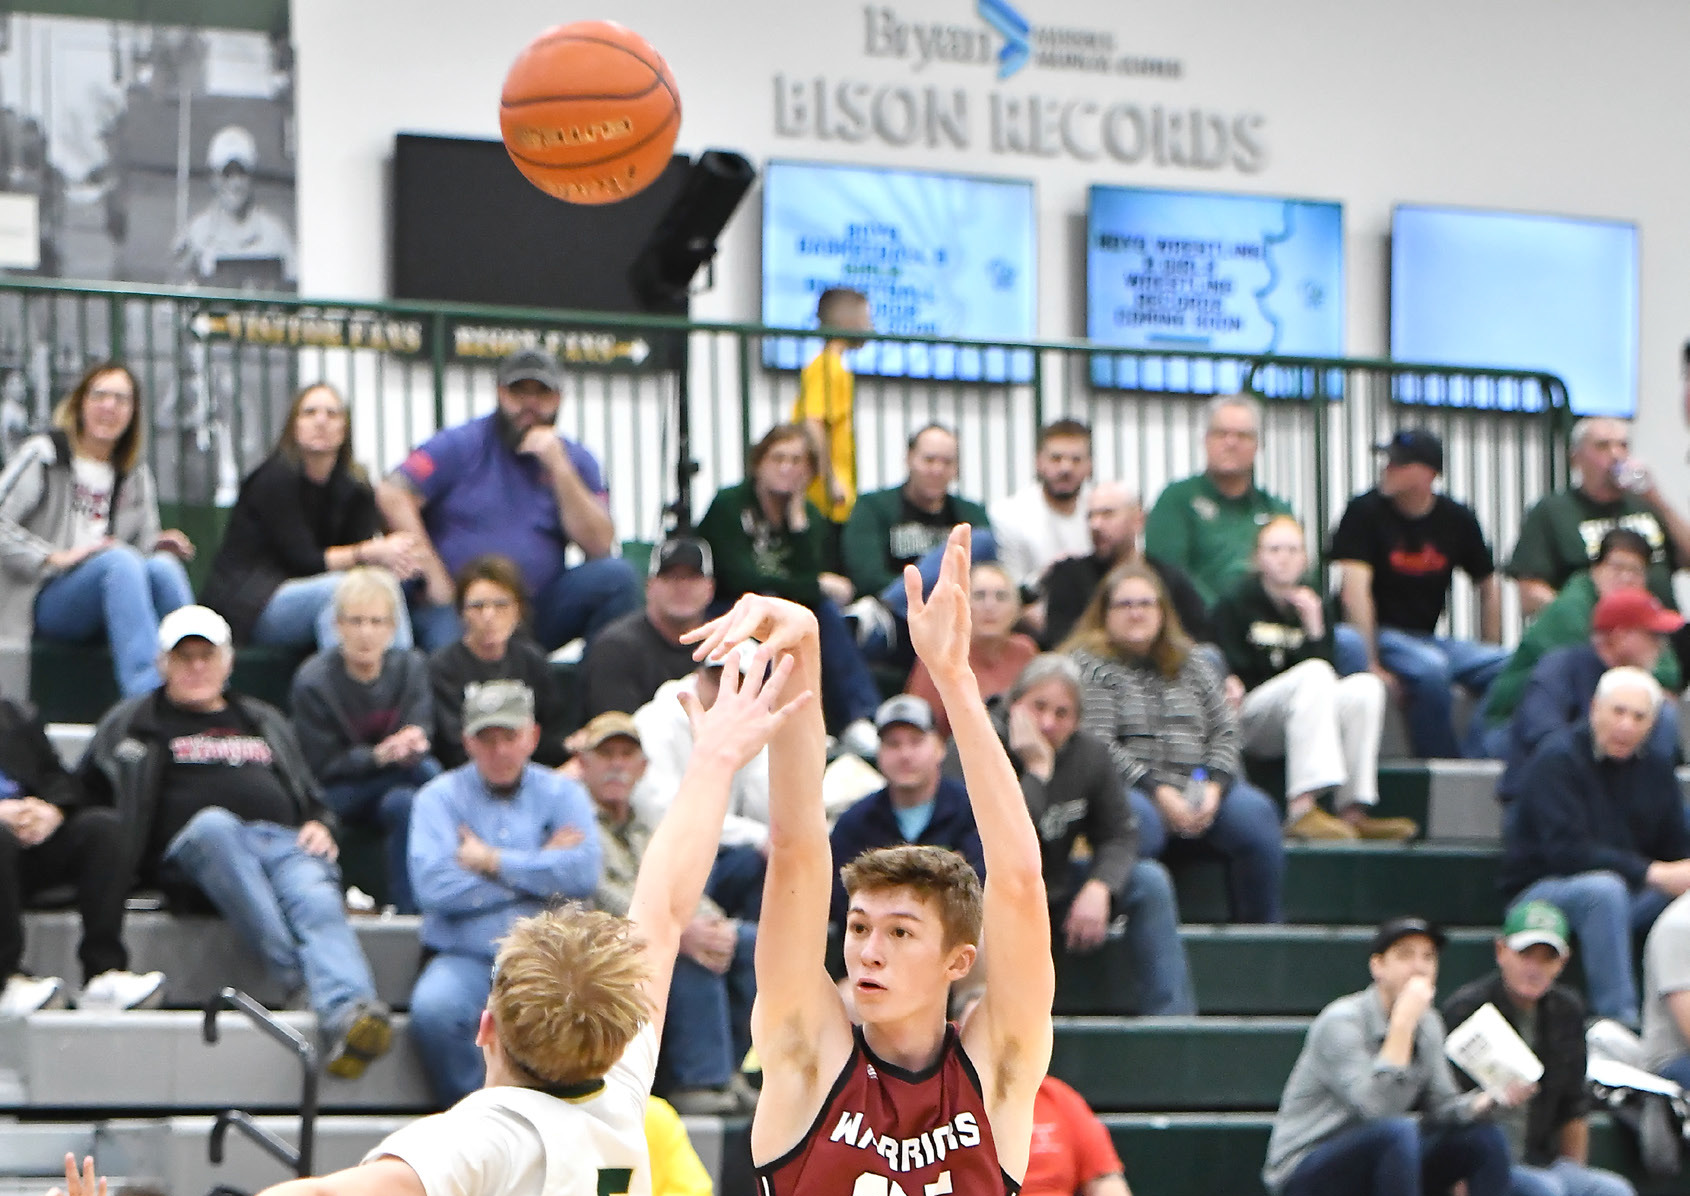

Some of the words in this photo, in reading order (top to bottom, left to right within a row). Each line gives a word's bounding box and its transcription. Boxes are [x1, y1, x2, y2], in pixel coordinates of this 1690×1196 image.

[864, 5, 992, 73] Bryan
[773, 74, 969, 150] BISON
[989, 92, 1268, 173] RECORDS
